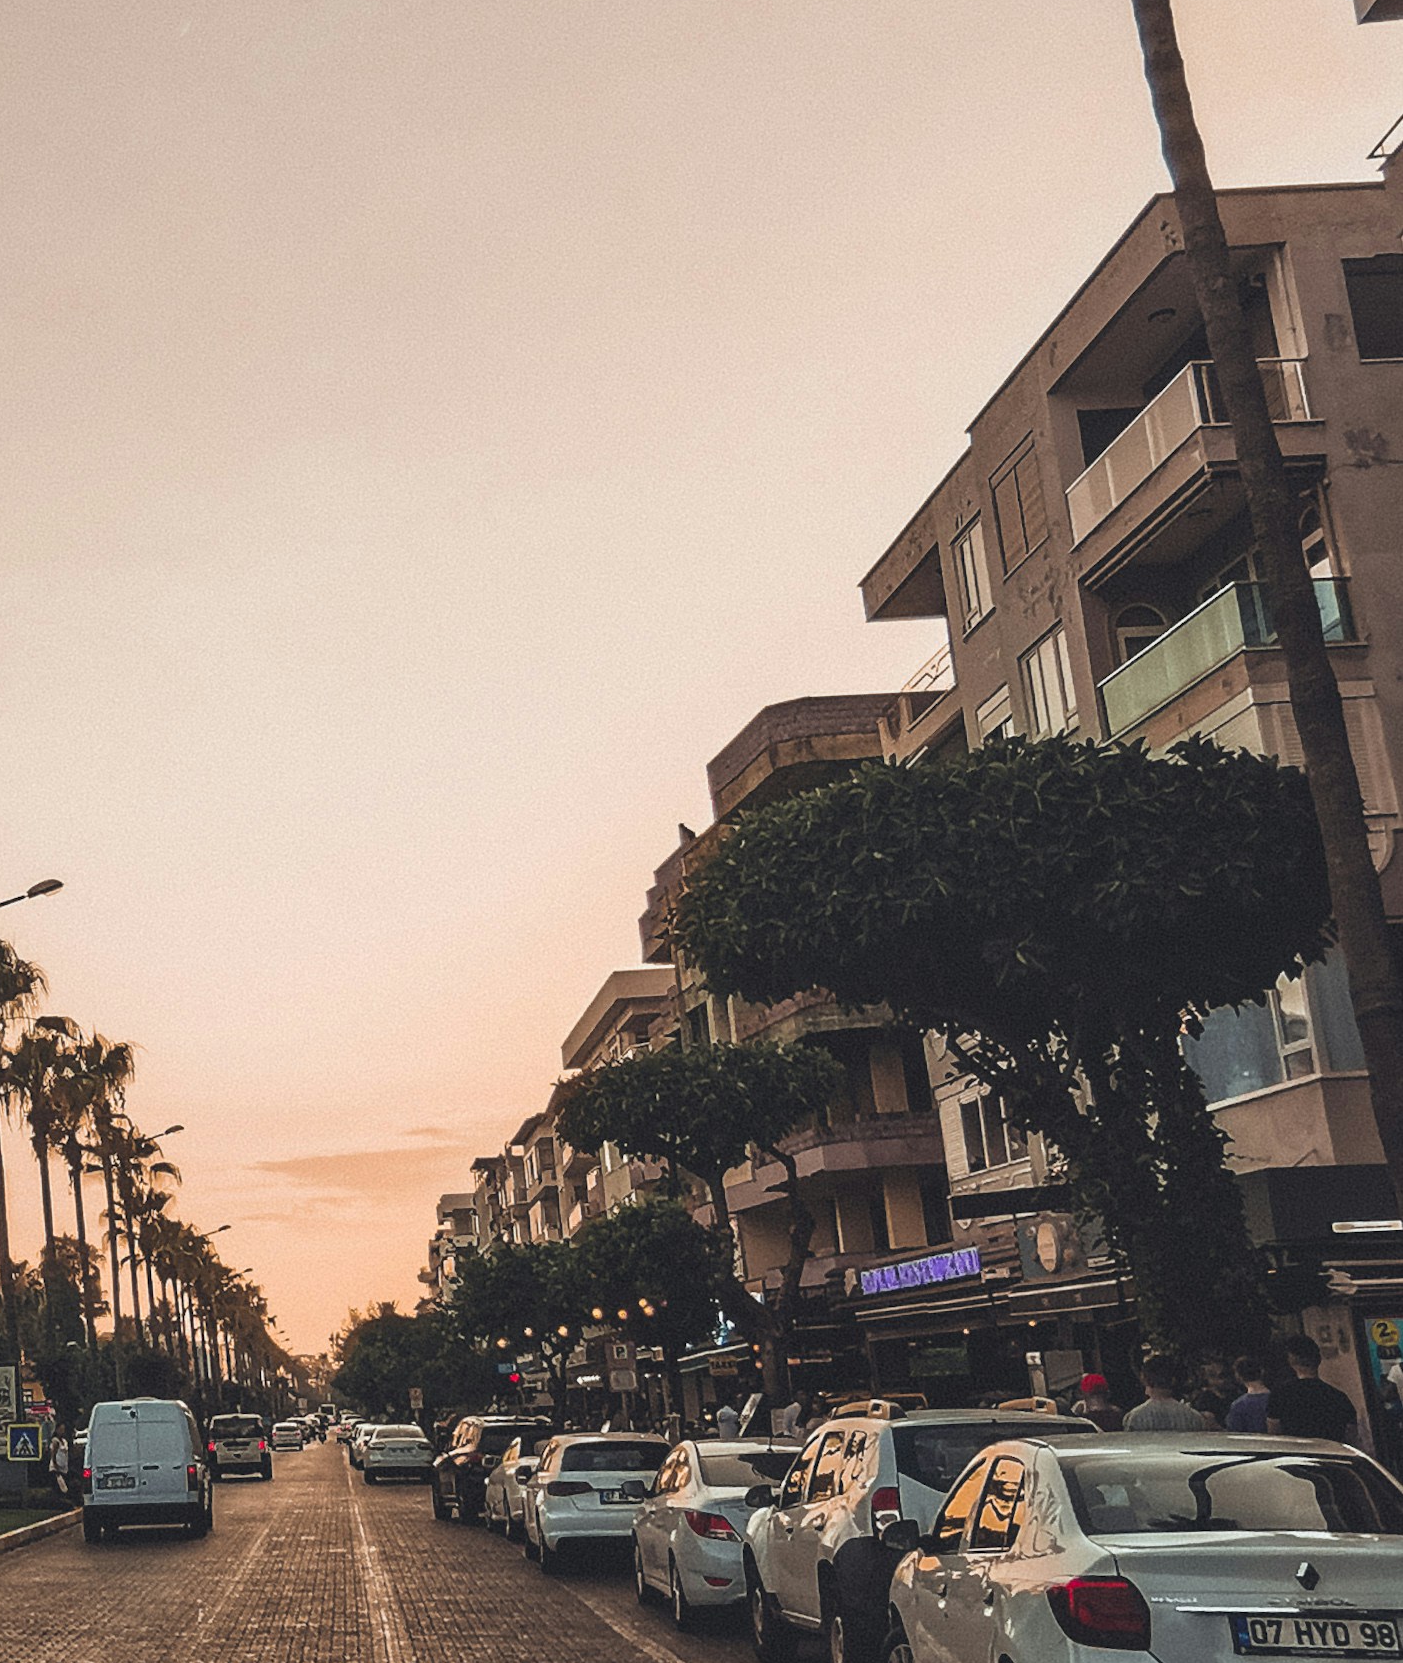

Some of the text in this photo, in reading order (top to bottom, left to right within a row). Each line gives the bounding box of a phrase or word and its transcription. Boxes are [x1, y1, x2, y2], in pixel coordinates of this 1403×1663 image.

[1249, 1619, 1396, 1648] 07 HYD 98
